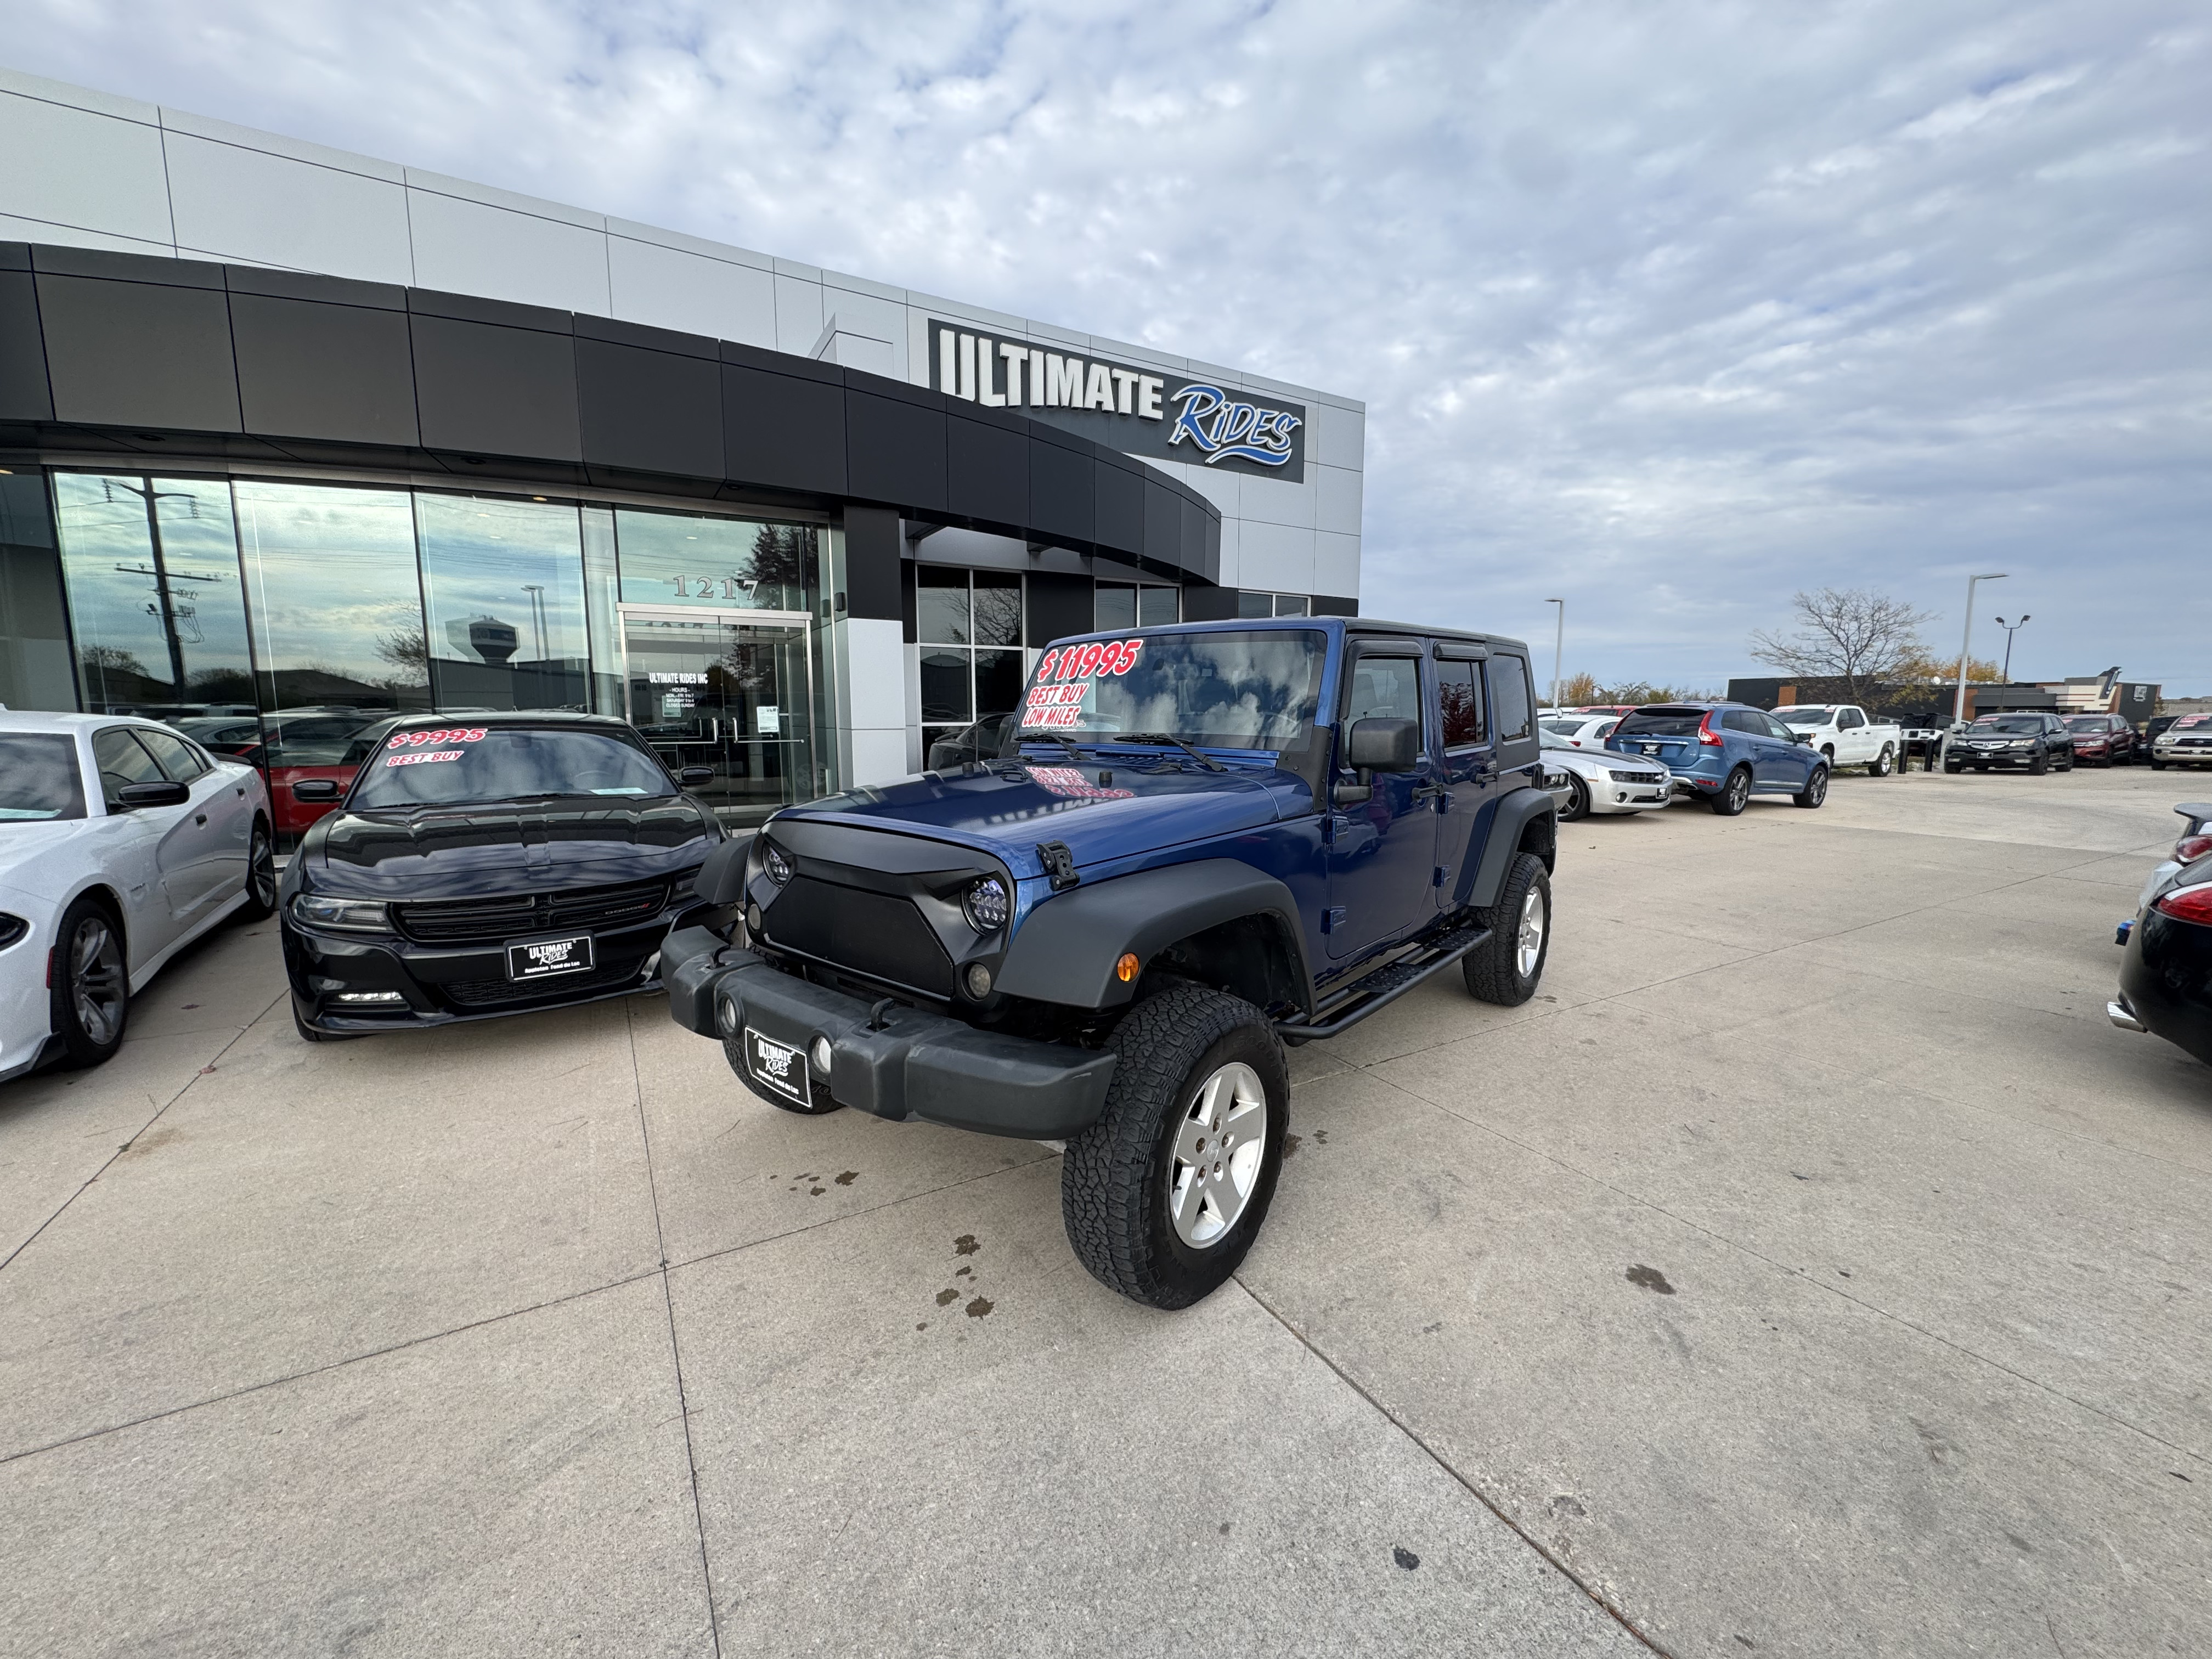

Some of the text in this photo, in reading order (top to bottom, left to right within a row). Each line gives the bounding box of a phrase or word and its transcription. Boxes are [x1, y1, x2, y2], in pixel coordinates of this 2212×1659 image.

[940, 328, 1164, 420] ULTIMATE
[673, 575, 758, 601] 1217
[649, 673, 708, 684] ULTIMATE RIDES INC
[1027, 683, 1090, 707] BEST BUY
[1022, 707, 1045, 727] LOW
[1044, 706, 1081, 727] MILES
[387, 729, 488, 749] $9995
[386, 751, 465, 767] BEST BUY
[529, 942, 572, 960] ULTIMATE
[759, 1039, 792, 1064] ULTIMATE
